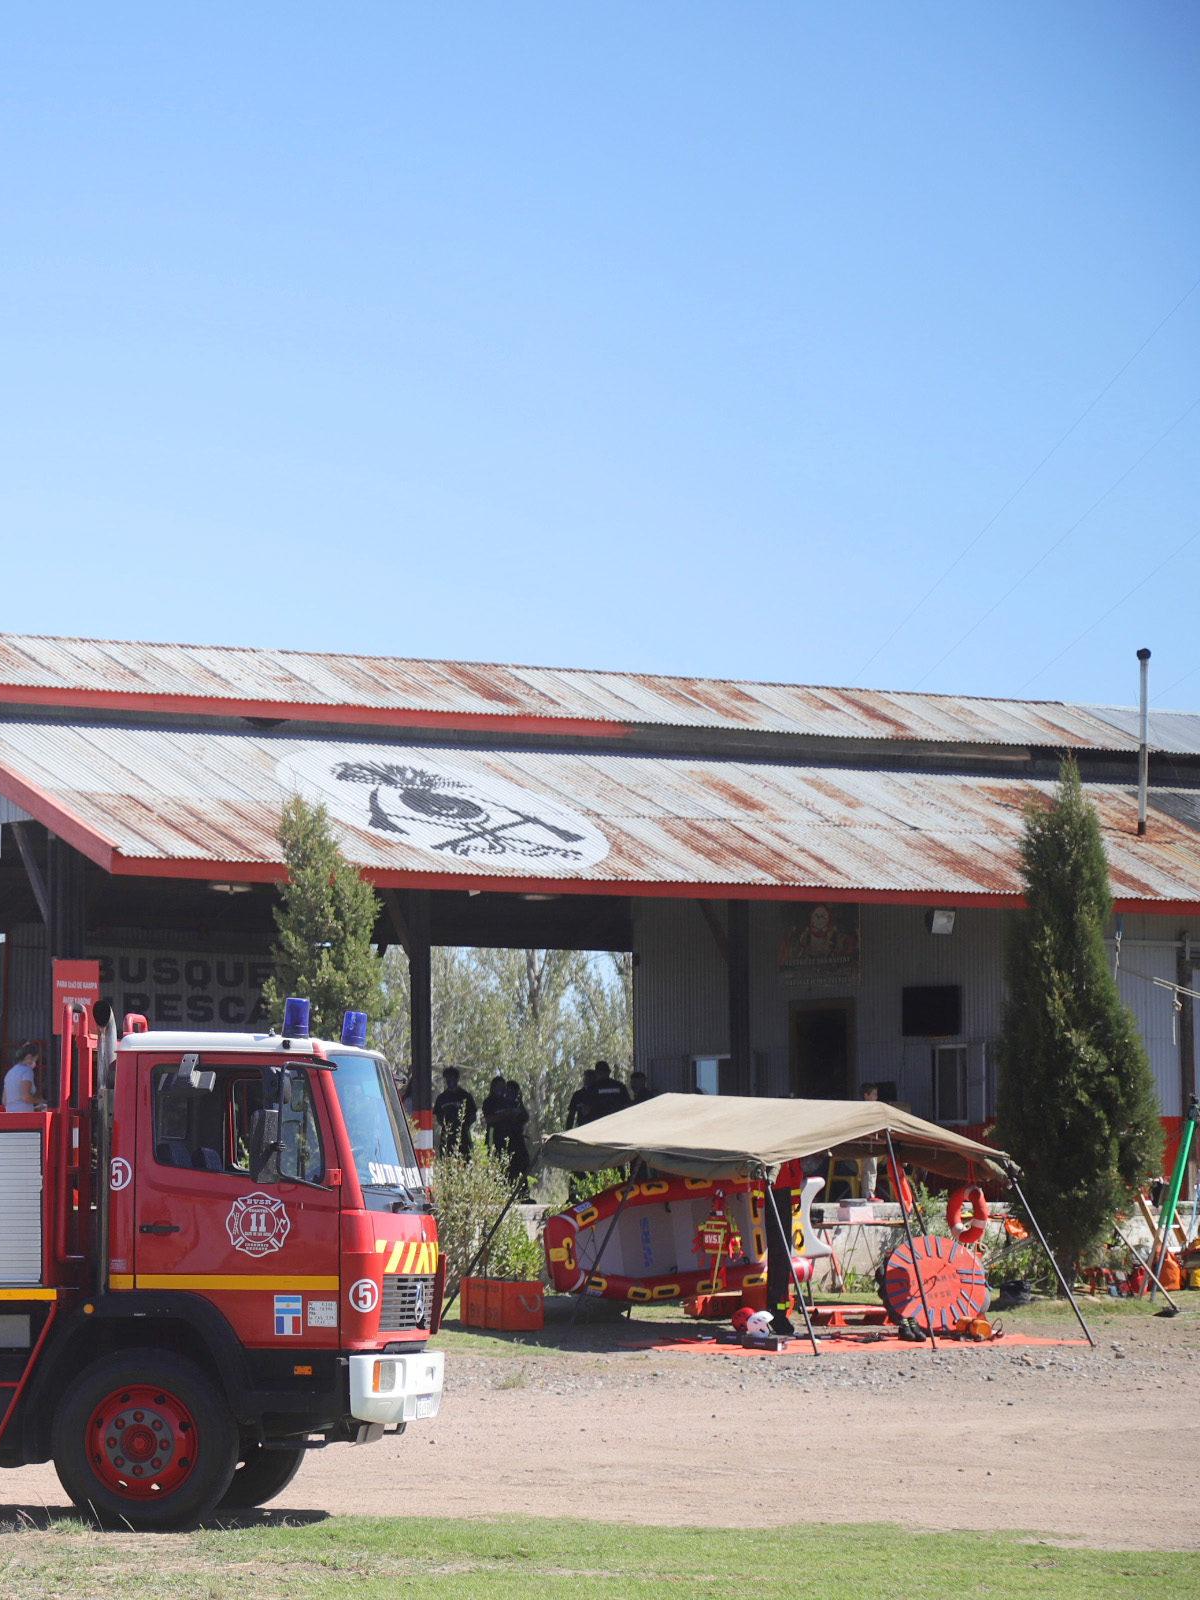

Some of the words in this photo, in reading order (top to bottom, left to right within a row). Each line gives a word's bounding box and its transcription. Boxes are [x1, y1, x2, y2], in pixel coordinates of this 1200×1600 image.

[111, 1162, 123, 1187] 5
[250, 1213, 267, 1232] 11
[358, 1283, 372, 1309] 5
